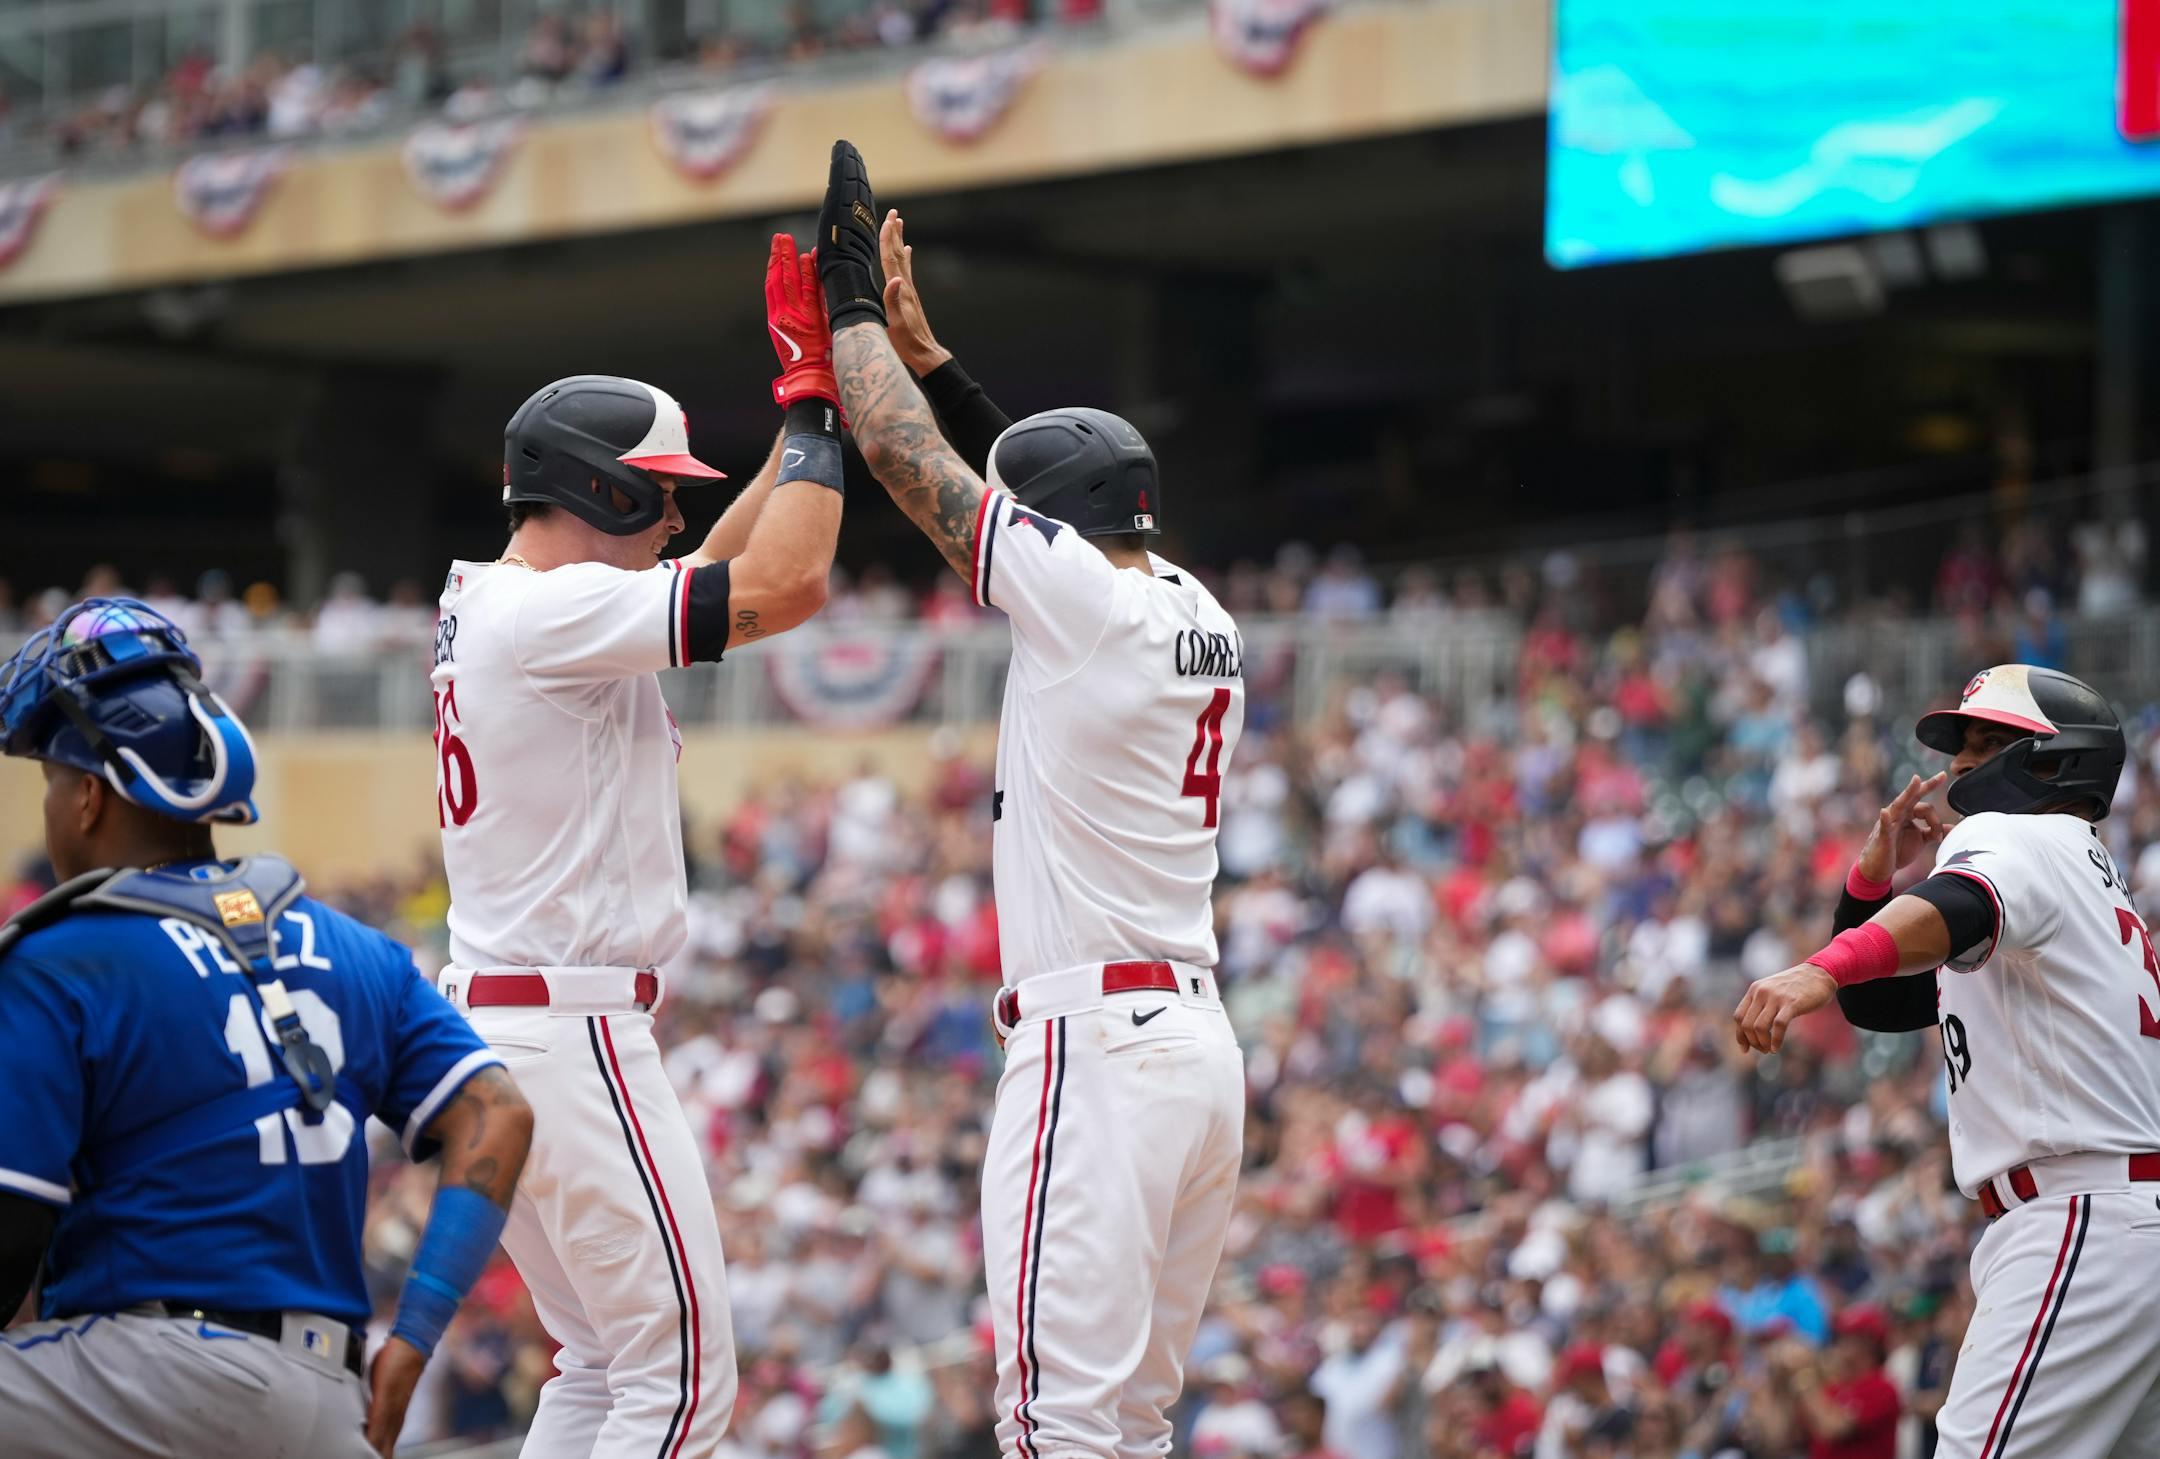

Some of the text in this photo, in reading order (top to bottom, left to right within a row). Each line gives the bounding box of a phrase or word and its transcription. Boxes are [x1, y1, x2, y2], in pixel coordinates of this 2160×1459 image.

[1136, 489, 1149, 510] 4
[1175, 629, 1243, 678] CORREA
[1181, 688, 1231, 828] 4
